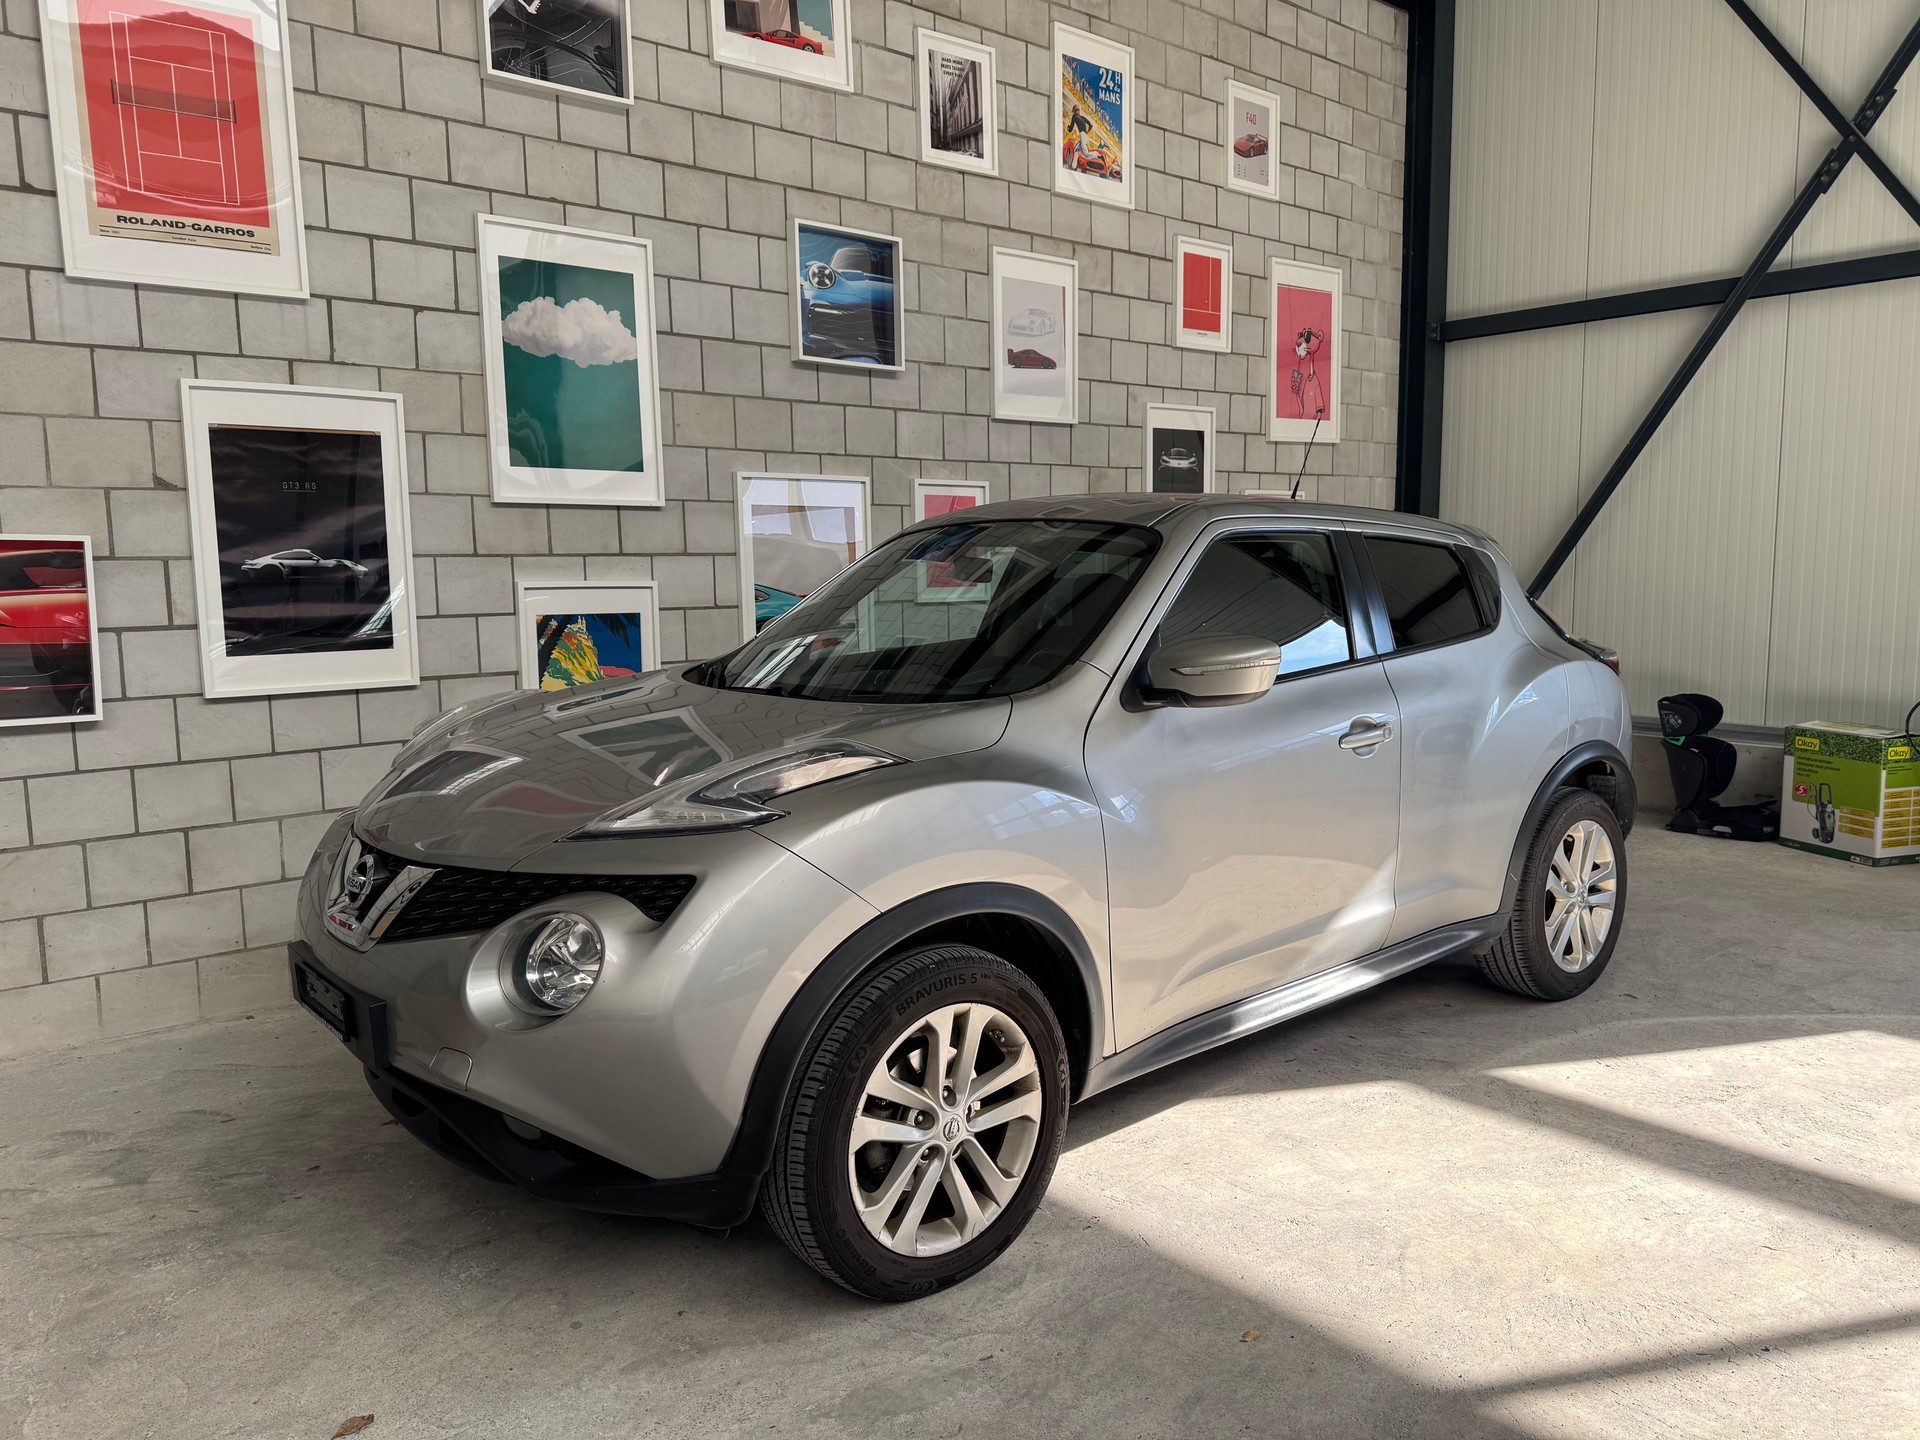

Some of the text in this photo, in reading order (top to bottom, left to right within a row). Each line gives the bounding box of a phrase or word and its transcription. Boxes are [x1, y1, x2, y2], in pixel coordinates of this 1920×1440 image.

[1099, 67, 1120, 90] 24 H
[1099, 89, 1120, 105] MANS
[1246, 112, 1256, 125] F40
[116, 215, 255, 238] ROLAND-GARROS
[282, 481, 317, 490] GT3 RS
[1796, 738, 1818, 749] Okay
[1889, 749, 1909, 758] Okay
[895, 974, 966, 1016] BRAVURIS
[970, 973, 978, 984] 5
